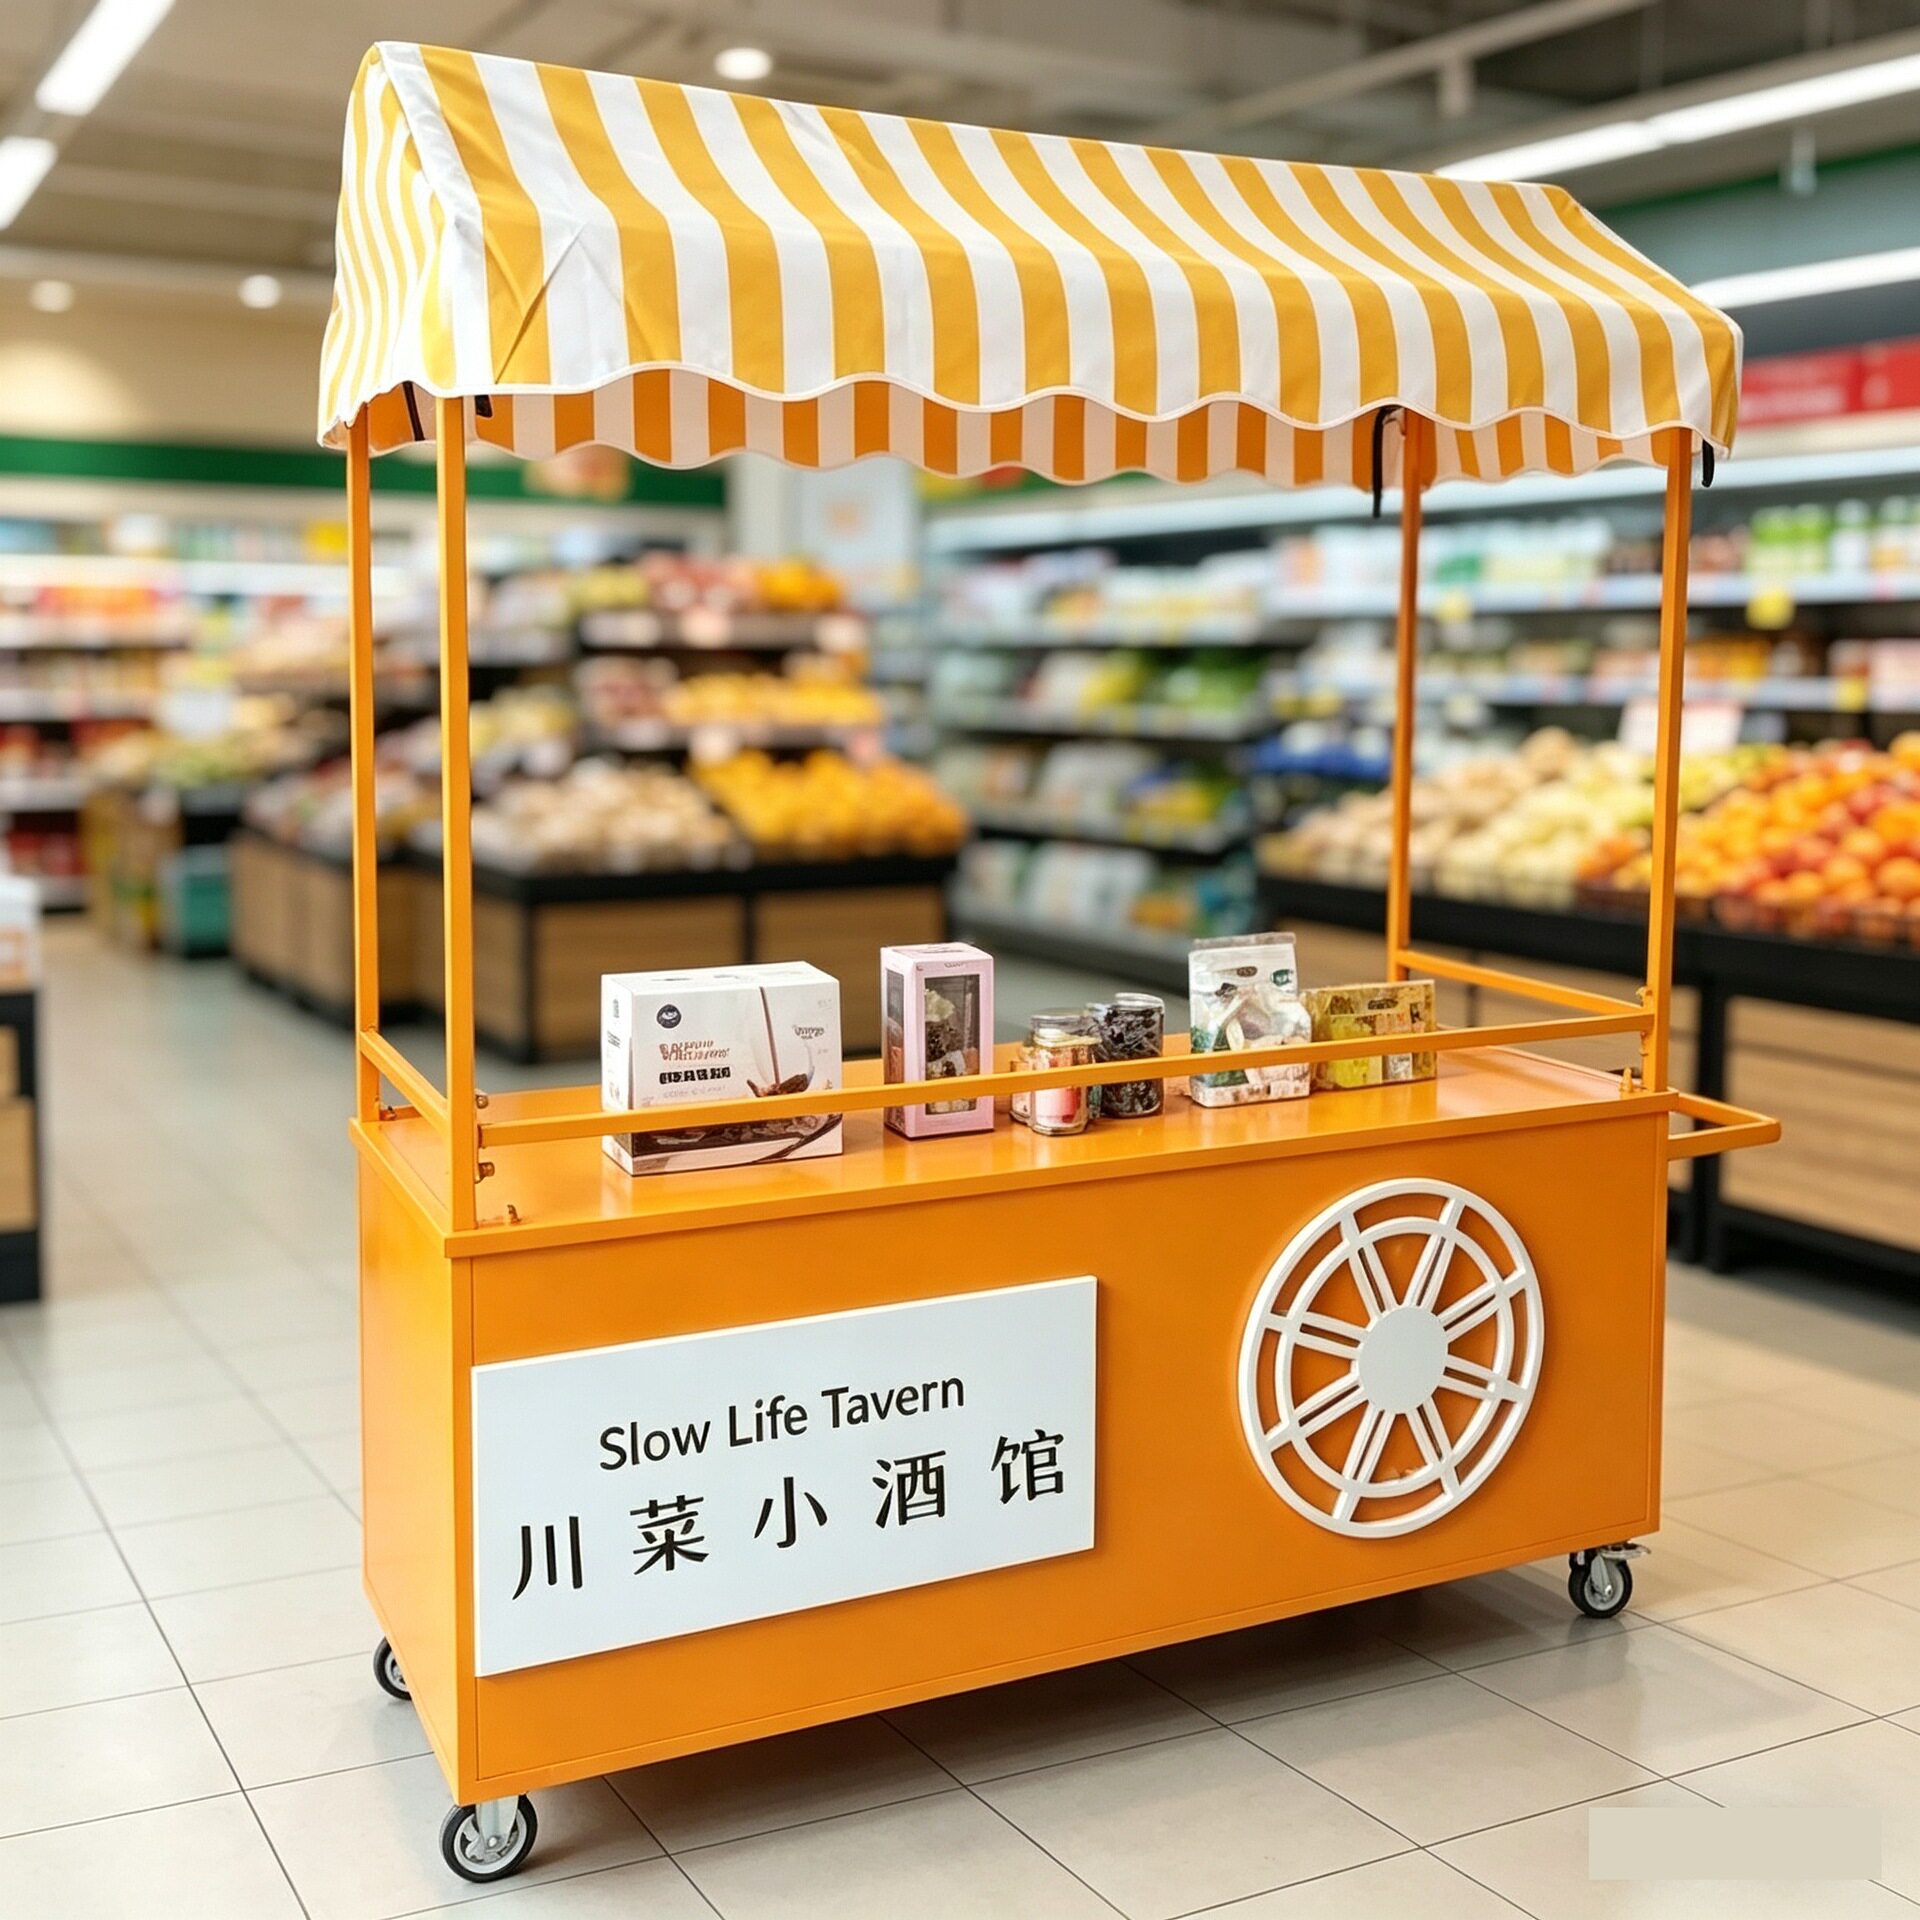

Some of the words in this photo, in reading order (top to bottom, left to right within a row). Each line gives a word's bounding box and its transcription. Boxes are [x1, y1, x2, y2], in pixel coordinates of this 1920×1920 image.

[599, 1420, 711, 1471] Slow
[728, 1394, 809, 1448] Life
[820, 1376, 965, 1429] Tavern
[511, 1427, 1066, 1602] 川菜小酒馆
